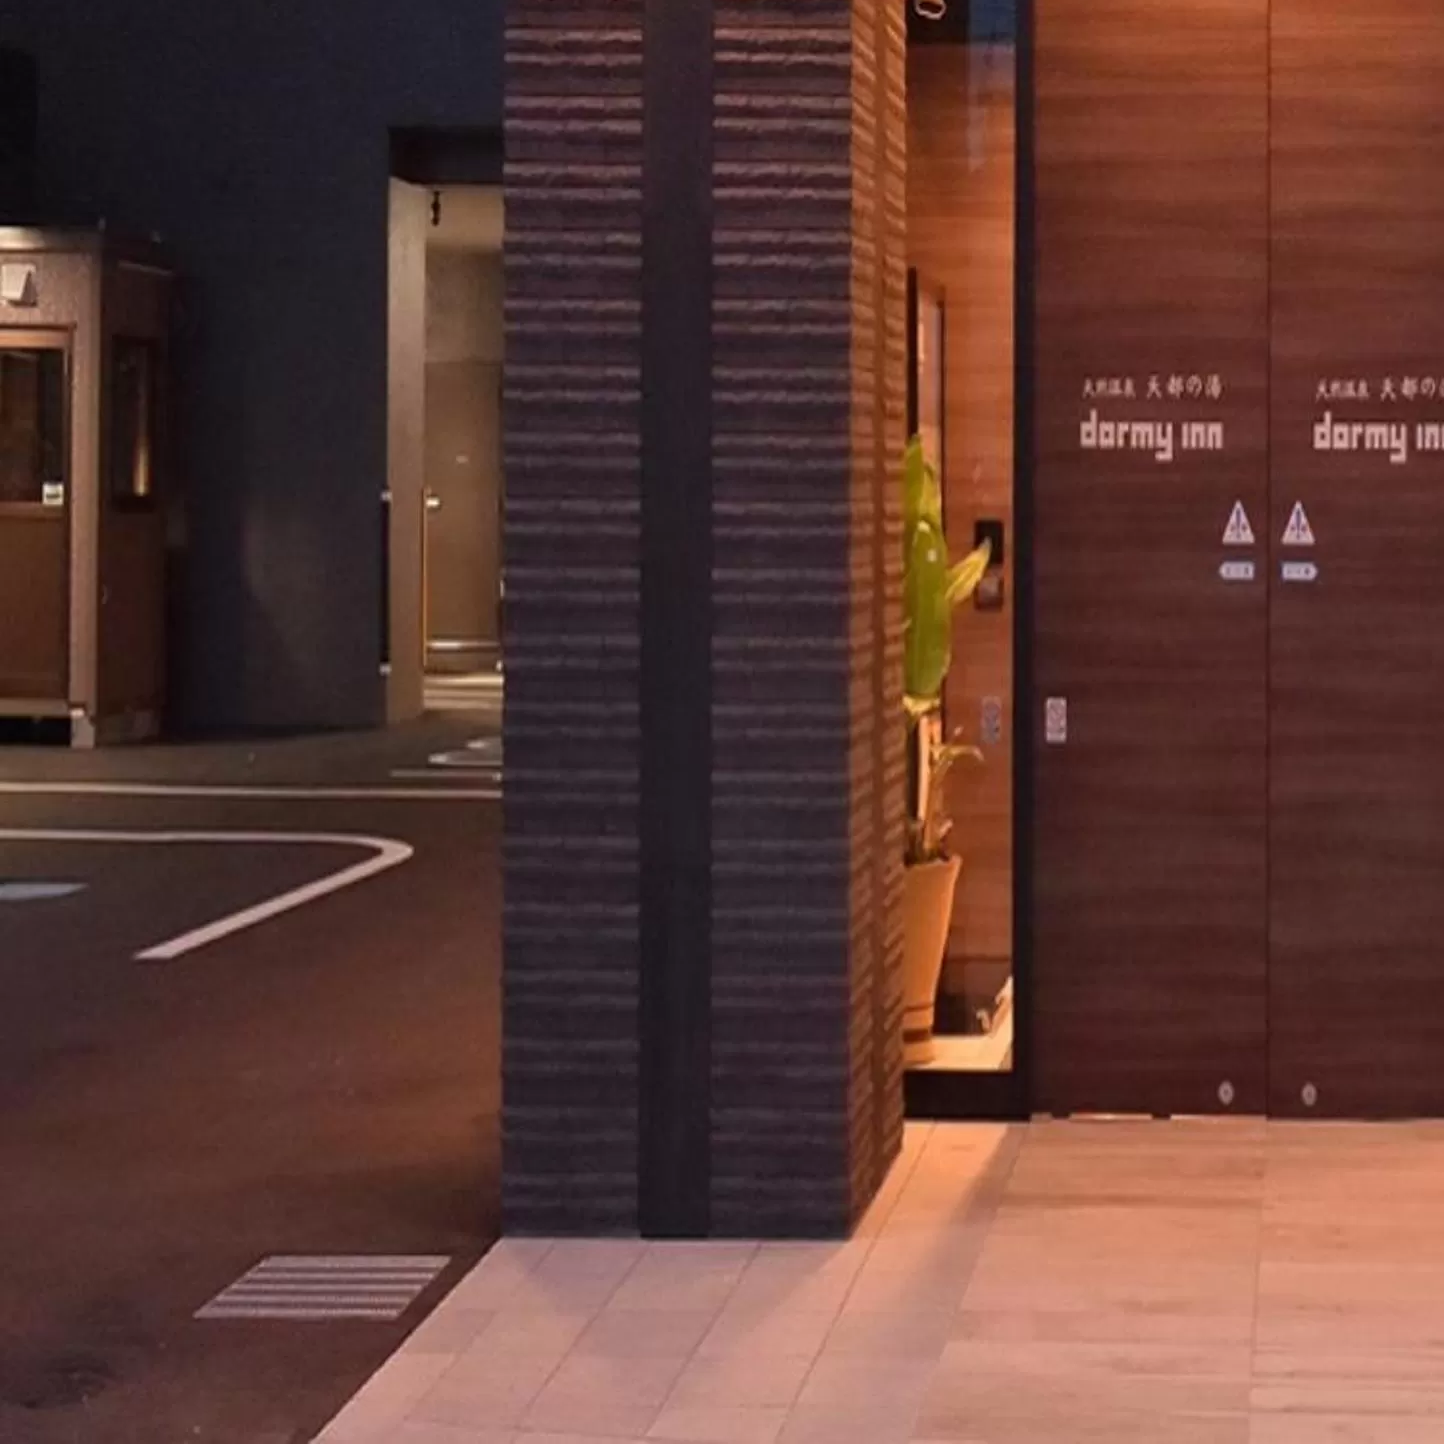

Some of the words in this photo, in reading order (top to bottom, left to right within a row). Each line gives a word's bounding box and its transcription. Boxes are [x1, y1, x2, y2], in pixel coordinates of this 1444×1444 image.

[1080, 408, 1174, 462] dormy
[1181, 421, 1224, 450] inn
[1313, 410, 1408, 464] dormy
